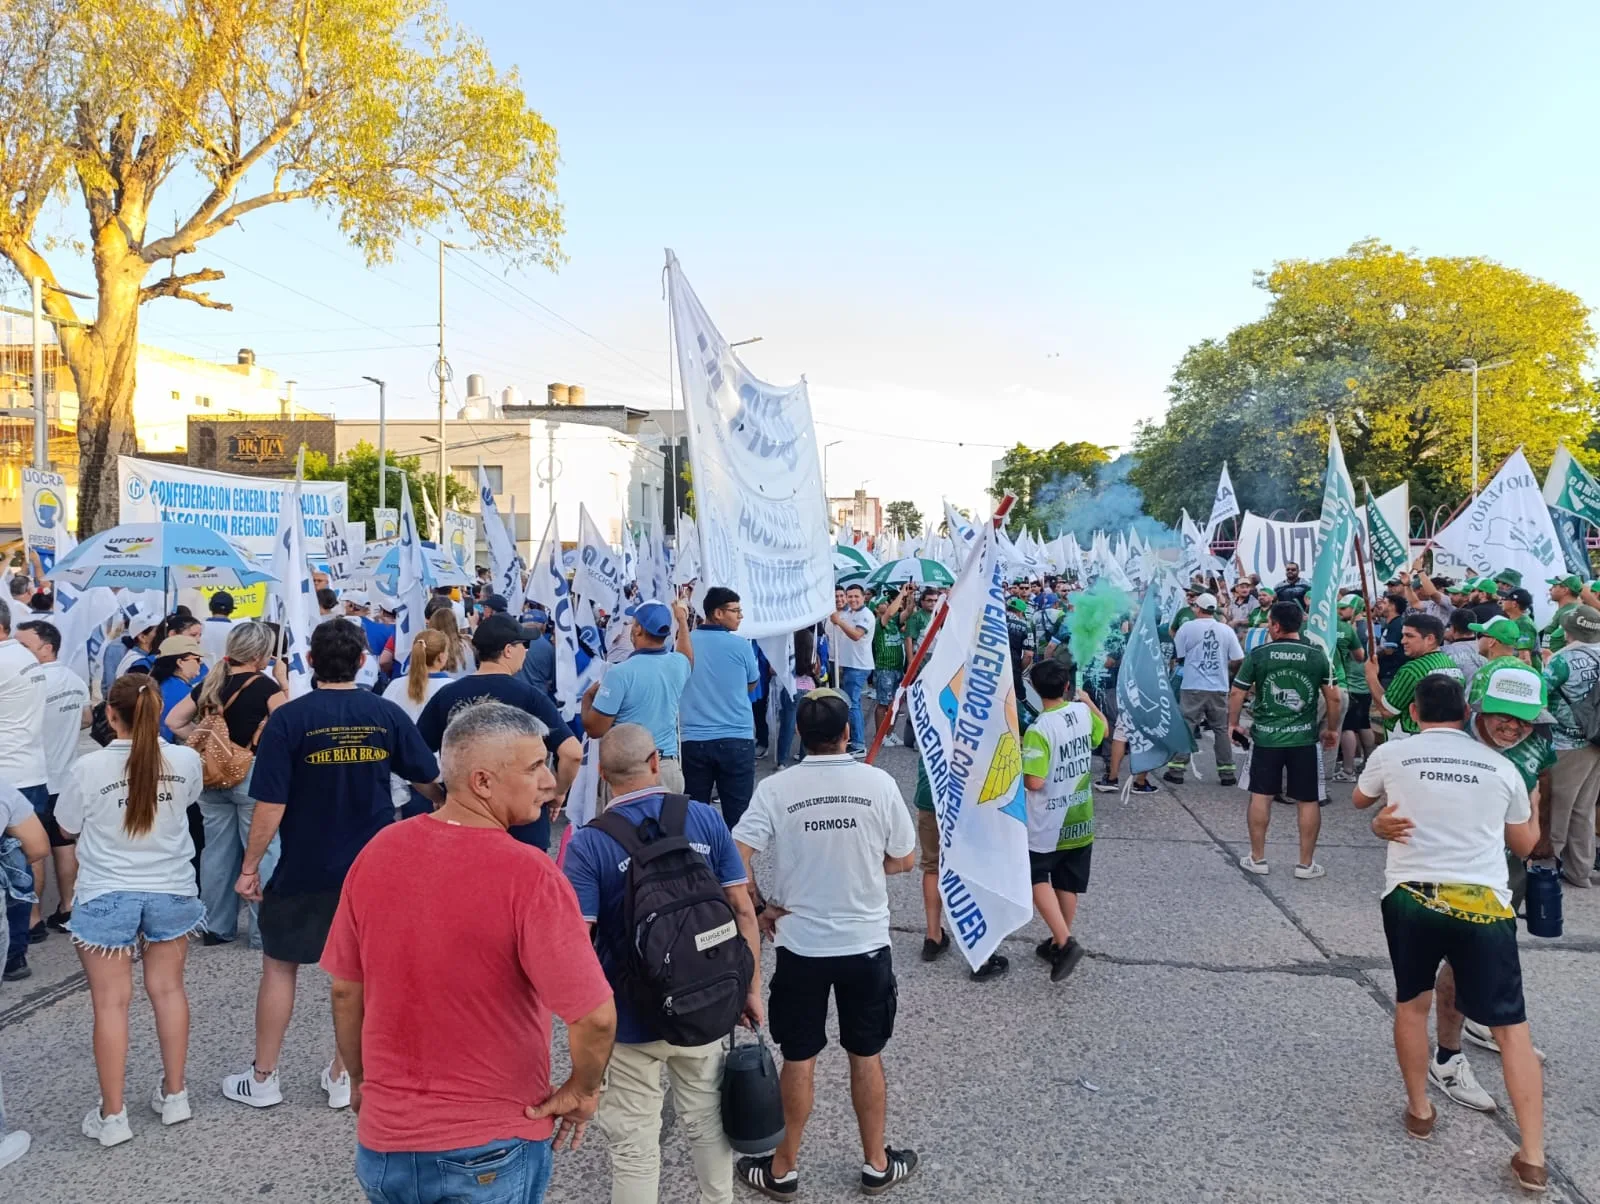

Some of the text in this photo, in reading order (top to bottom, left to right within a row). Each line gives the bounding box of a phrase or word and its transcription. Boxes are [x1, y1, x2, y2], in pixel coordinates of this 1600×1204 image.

[23, 470, 63, 486] UOCRA
[150, 480, 230, 510] CONFEDERACION
[233, 488, 267, 512] GENERAL
[174, 546, 229, 557] FORMOSA
[587, 569, 619, 592] SECCIONA
[1269, 651, 1307, 661] FORMOSA
[912, 679, 948, 804] SECRETARIA
[311, 751, 332, 763] THE
[360, 748, 387, 760] BRAND
[1420, 771, 1480, 784] FORMOSA
[787, 801, 806, 814] CENTRO
[847, 795, 872, 807] COMERCIO
[804, 818, 857, 832] FORMOSA
[1060, 820, 1093, 840] FORMO
[941, 868, 988, 950] MUJER
[1442, 1075, 1457, 1088] N
